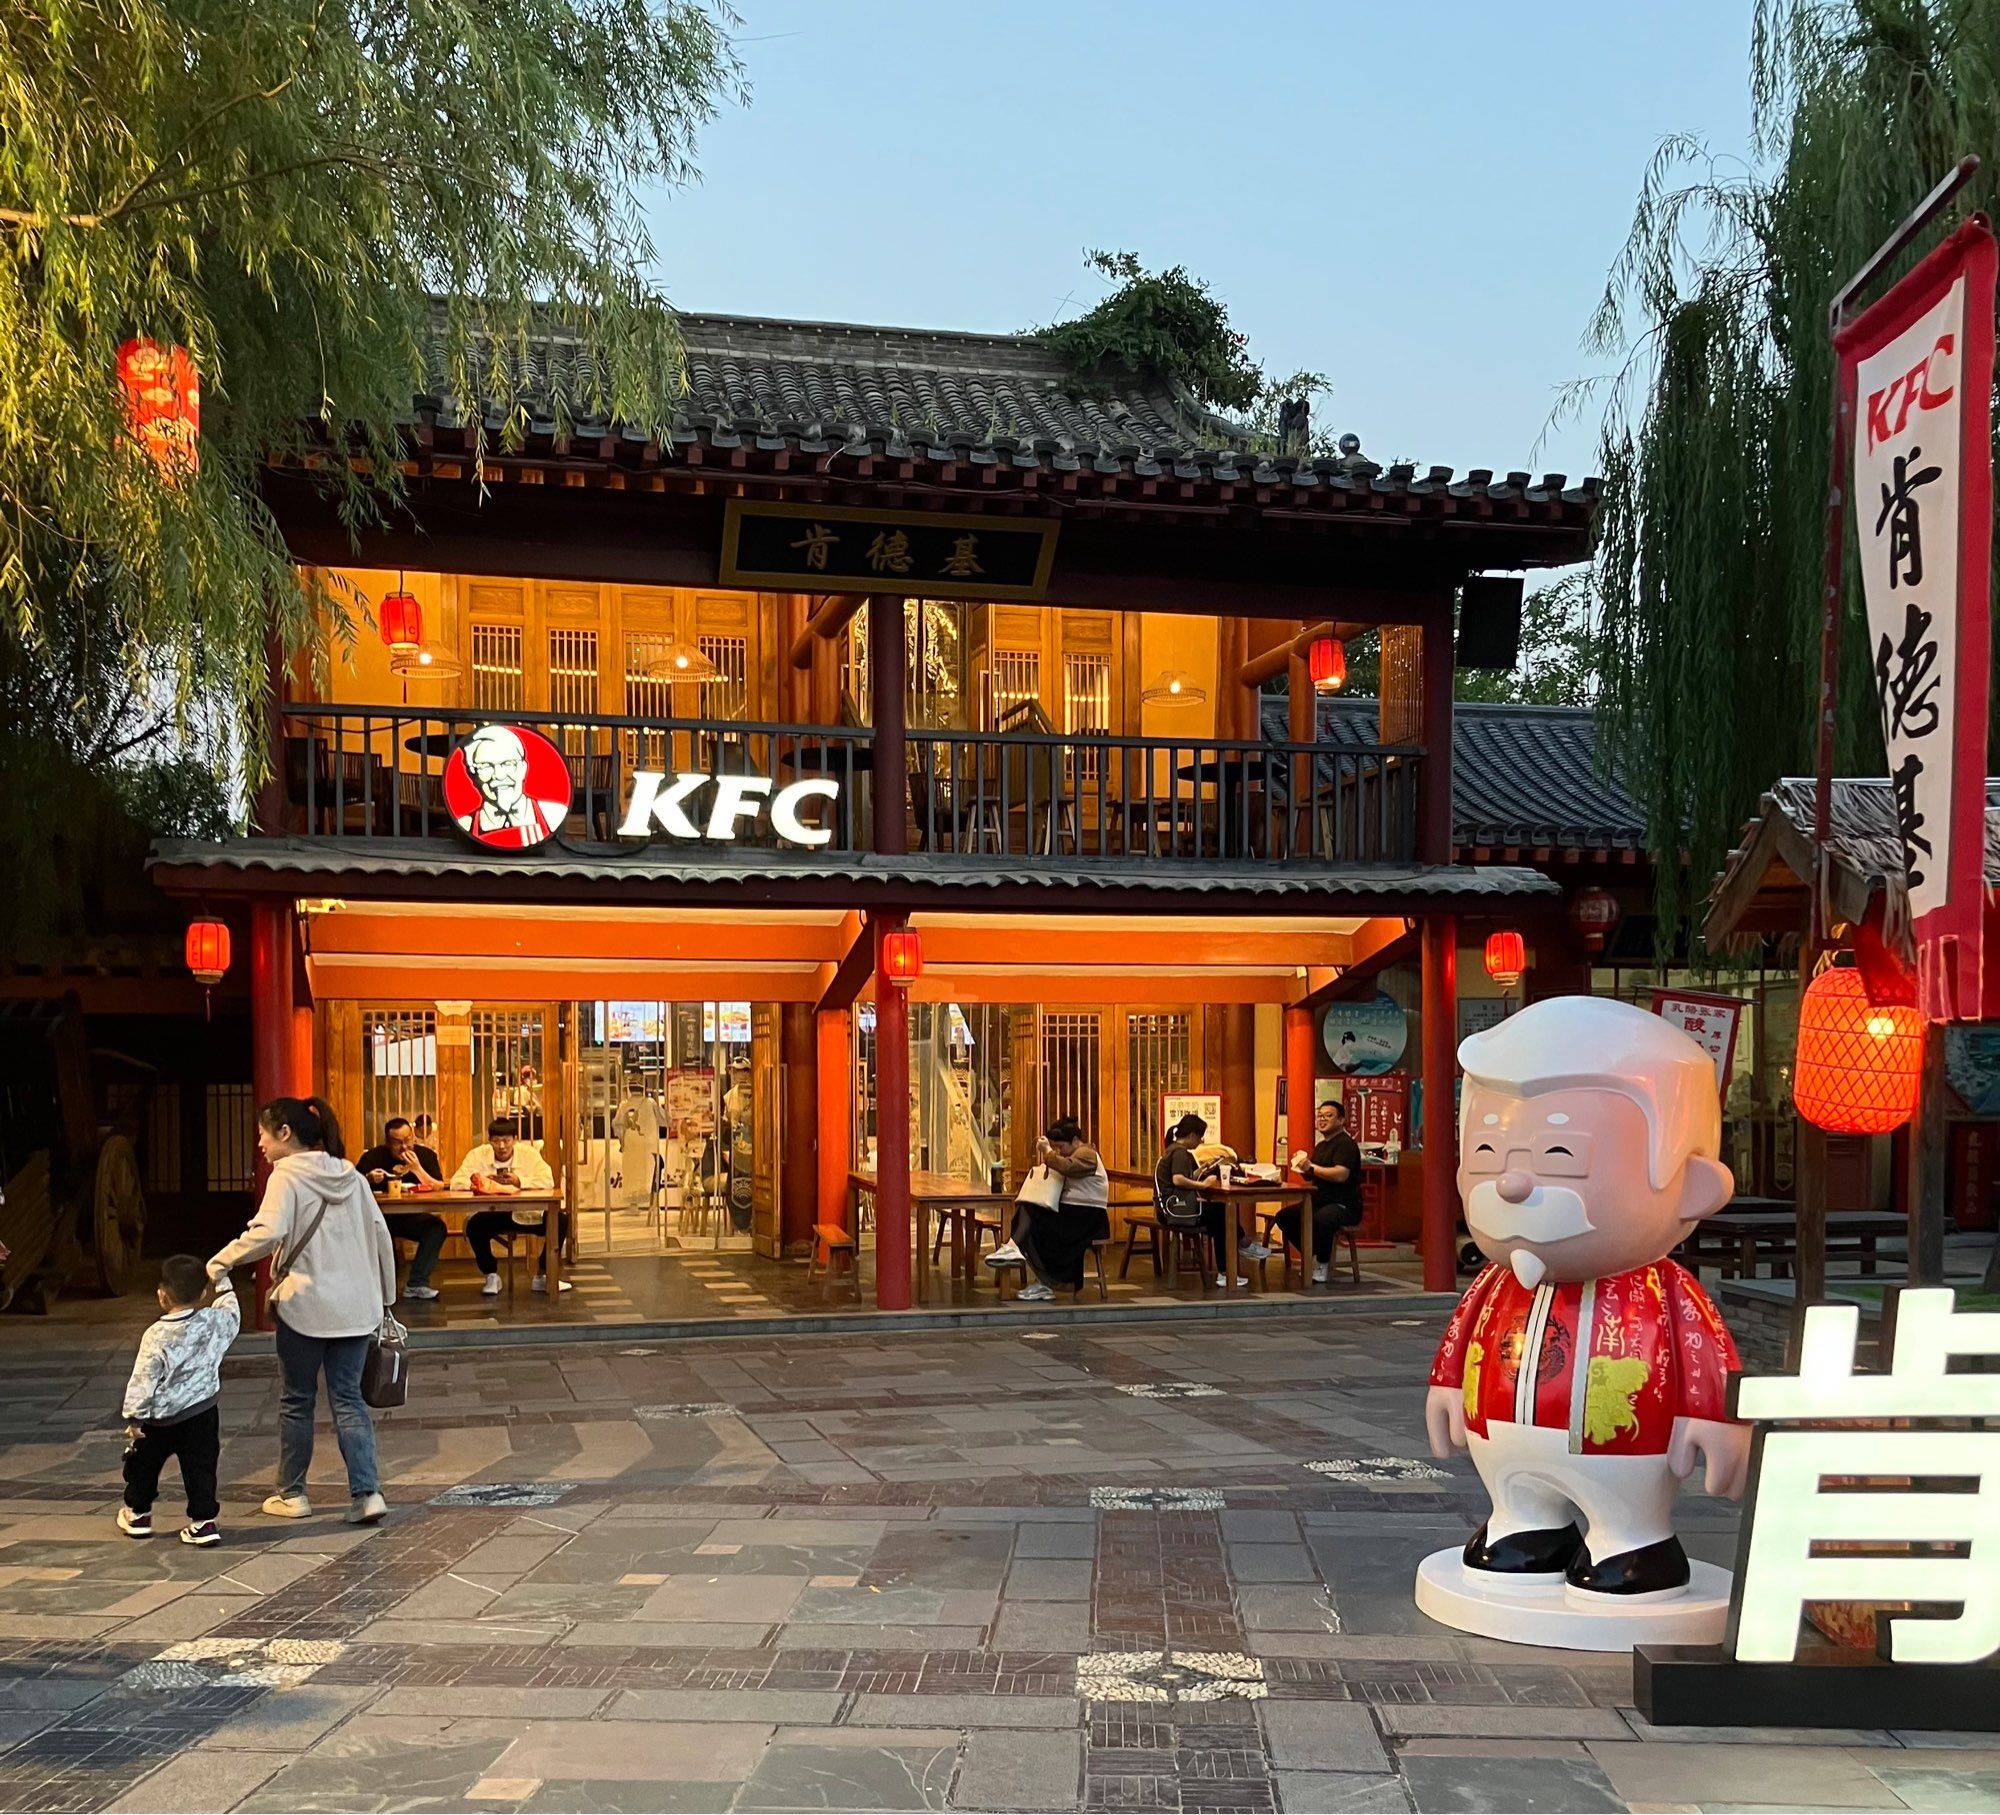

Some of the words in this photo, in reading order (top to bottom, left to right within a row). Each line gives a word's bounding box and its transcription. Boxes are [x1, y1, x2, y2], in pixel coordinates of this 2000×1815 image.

[1867, 333, 1955, 456] KFC
[790, 522, 986, 577] 肯德基
[1875, 446, 1944, 892] 肯德基
[617, 770, 840, 845] KFC
[1737, 1288, 2000, 1664] 肯
